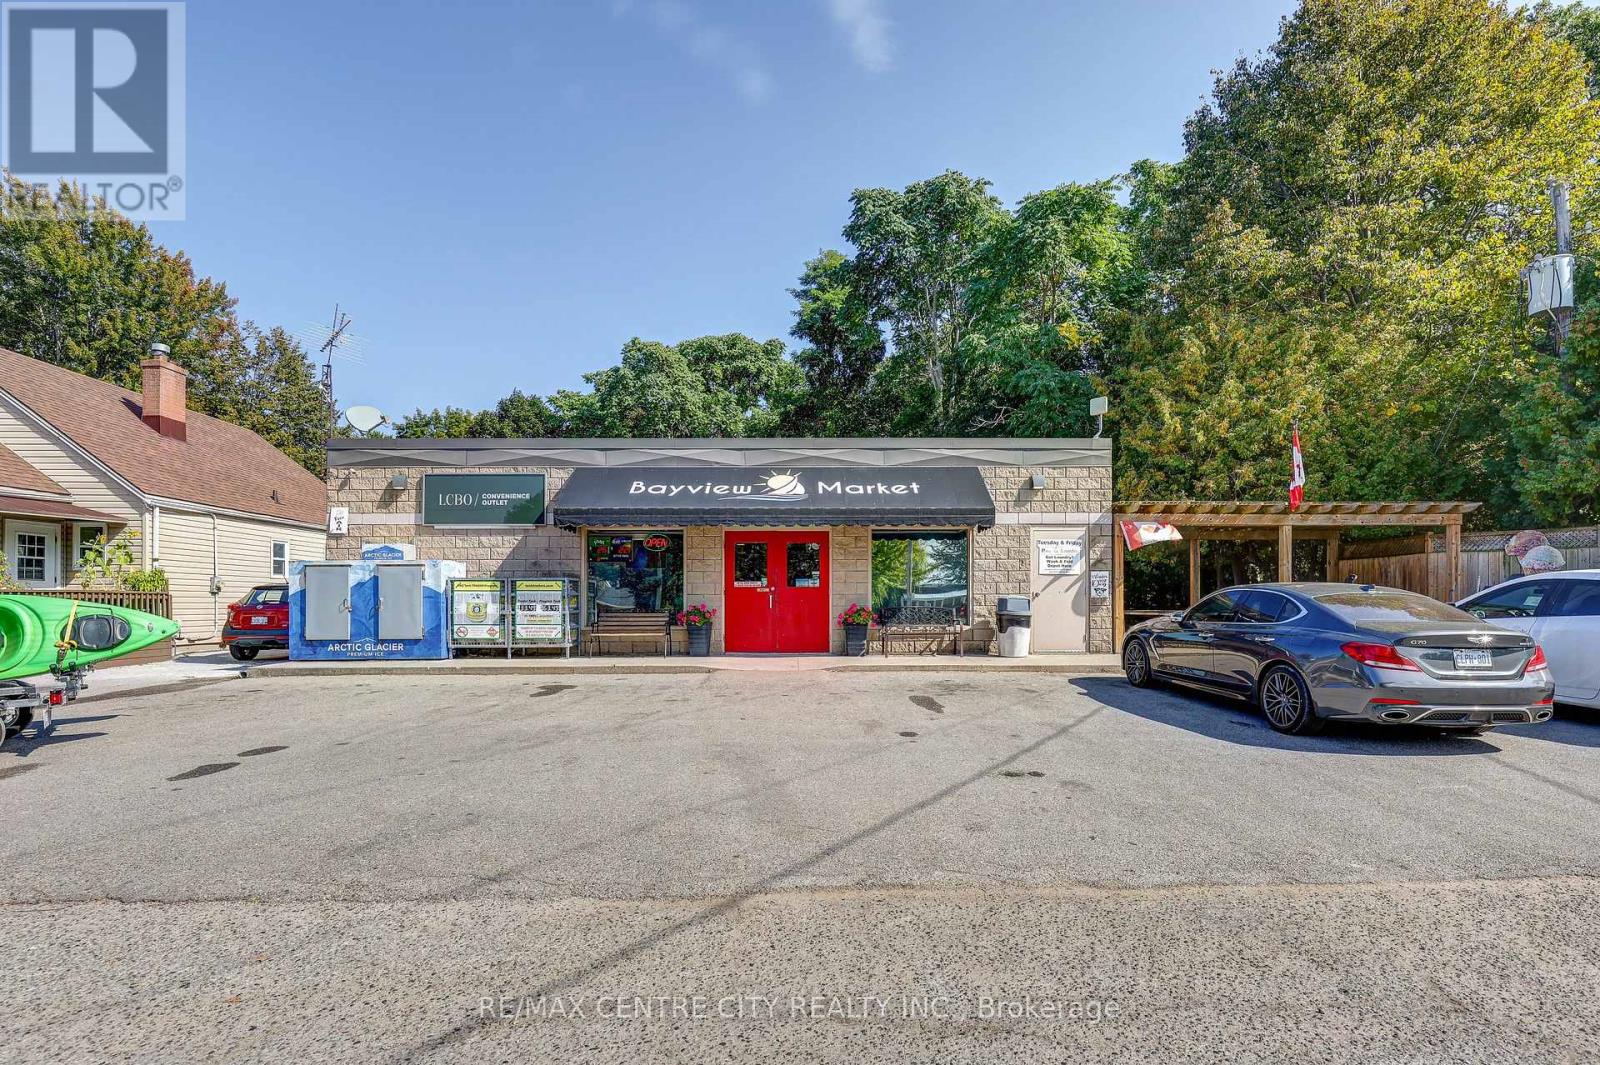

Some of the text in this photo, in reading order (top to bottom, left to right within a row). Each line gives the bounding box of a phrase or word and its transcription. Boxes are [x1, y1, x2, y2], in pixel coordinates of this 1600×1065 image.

[629, 481, 920, 497] Bayview Market
[438, 493, 472, 506] LCBO
[645, 538, 669, 548] OPEN
[327, 643, 404, 651] ARCTIC GLACIER
